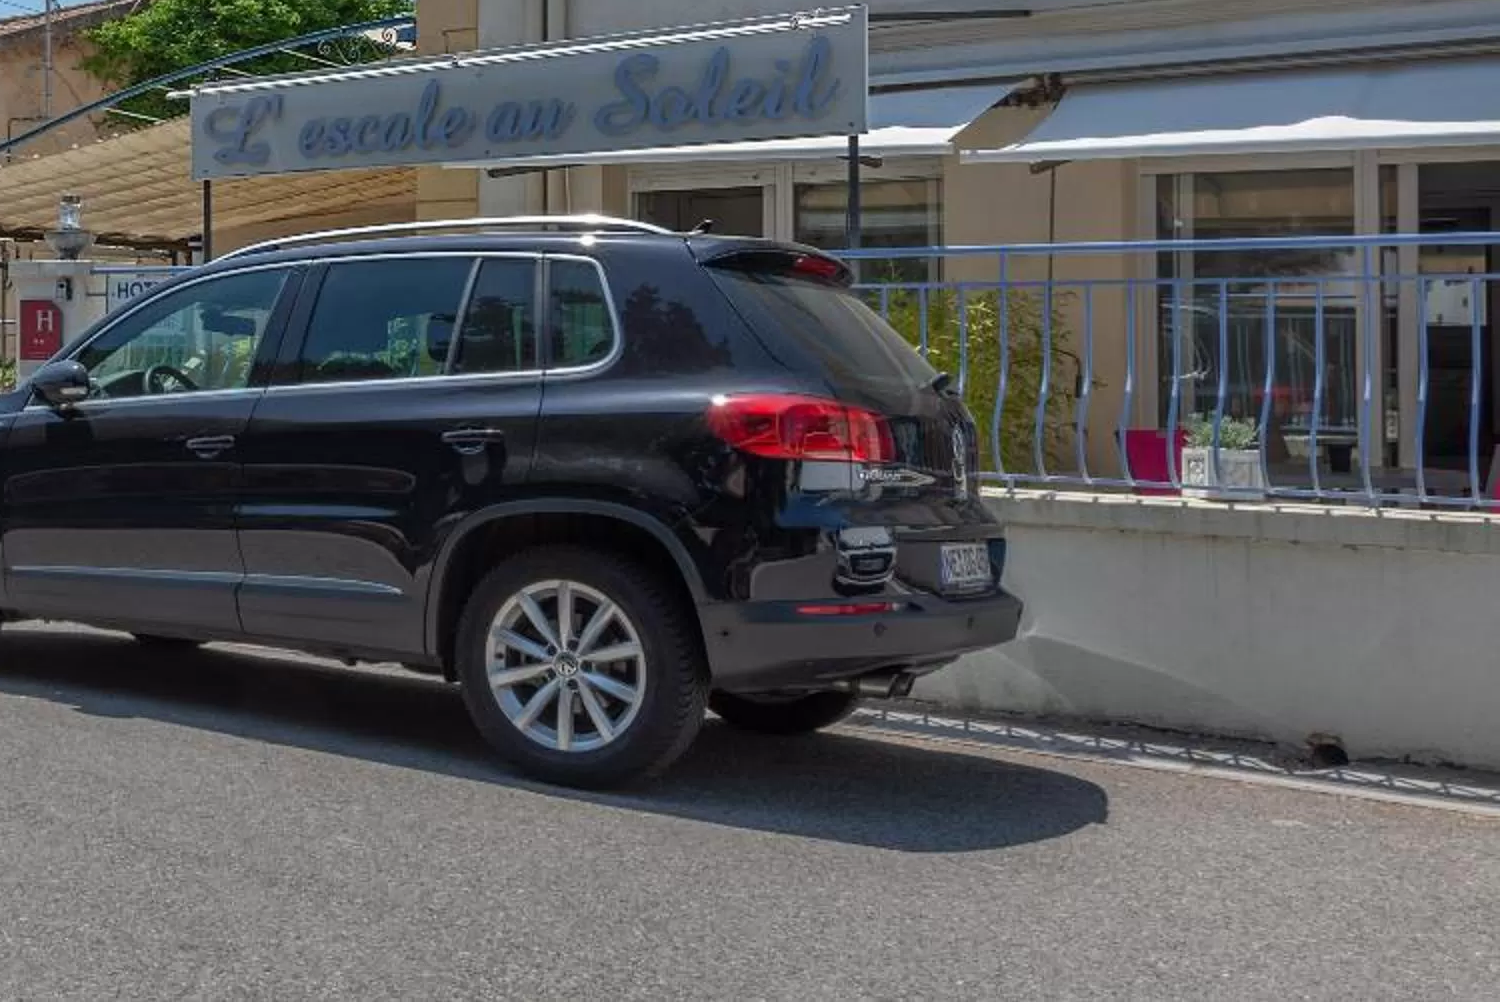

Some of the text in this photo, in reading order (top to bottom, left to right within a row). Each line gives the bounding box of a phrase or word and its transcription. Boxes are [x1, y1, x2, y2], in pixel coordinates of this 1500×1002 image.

[485, 98, 576, 143] au
[594, 34, 840, 136] Soleil
[37, 309, 53, 331] H
